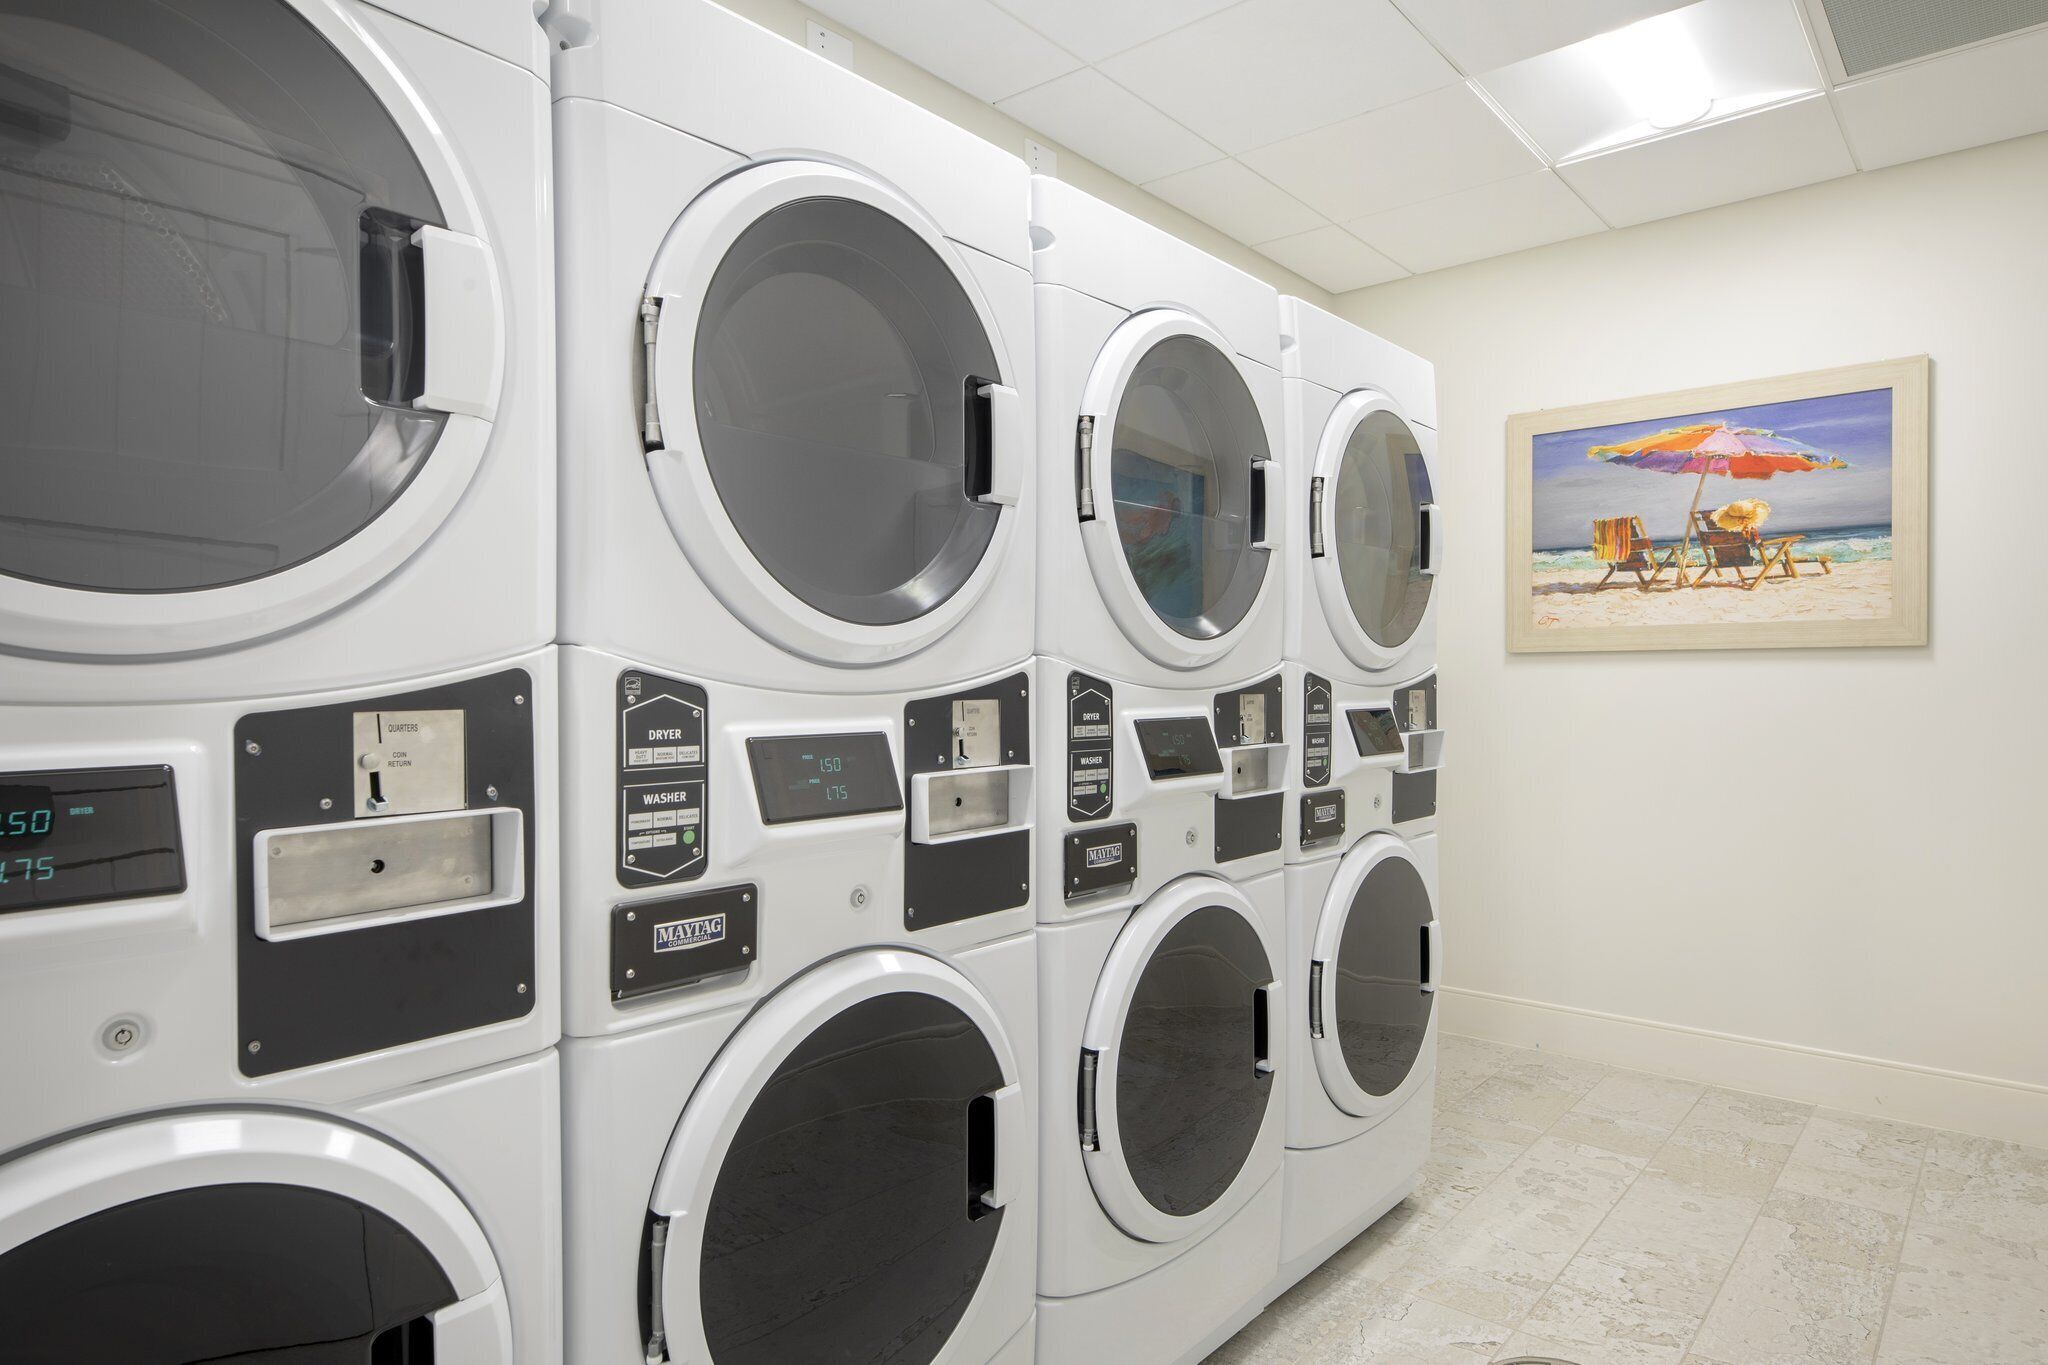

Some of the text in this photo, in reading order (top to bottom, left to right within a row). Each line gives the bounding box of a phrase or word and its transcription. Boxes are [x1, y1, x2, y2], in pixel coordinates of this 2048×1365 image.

[388, 723, 419, 732] QUARTERS
[648, 729, 682, 740] DRYER
[820, 757, 841, 772] 1.50
[1080, 756, 1103, 765] WASHER
[643, 791, 687, 805] WASHER
[826, 785, 848, 800] 1.75
[1089, 845, 1120, 861] MAYTAG
[657, 918, 722, 944] MAYTAG
[668, 934, 711, 948] COMMERCIAL
